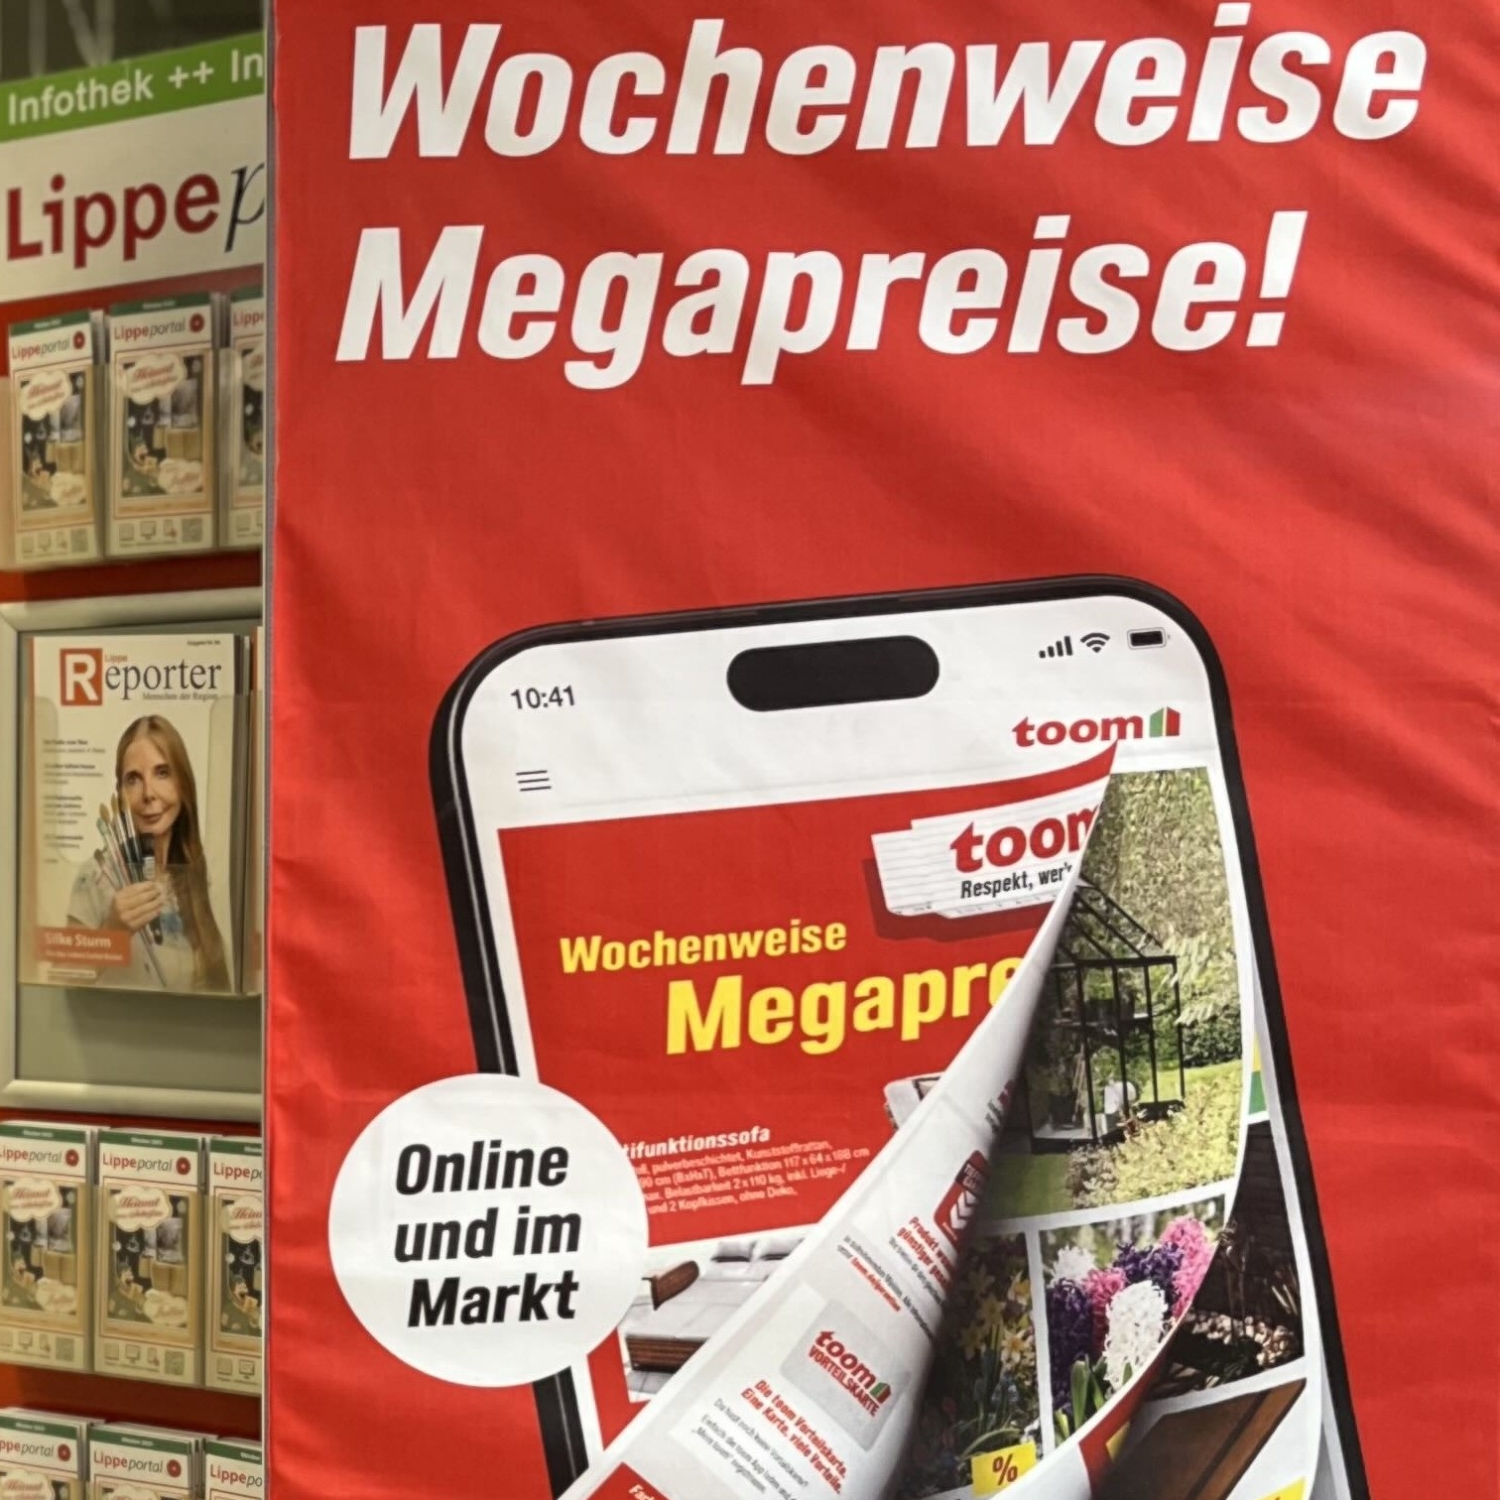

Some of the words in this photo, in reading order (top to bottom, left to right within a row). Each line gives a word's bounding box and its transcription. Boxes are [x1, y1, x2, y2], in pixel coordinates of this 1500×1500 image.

[8, 69, 154, 126] Infothek
[349, 2, 1427, 159] Wochenweise
[335, 211, 1308, 389] Megapreise!
[11, 337, 70, 360] Lippeportal
[113, 318, 186, 341] Lippeportal
[510, 685, 577, 712] 10:41
[1012, 710, 1143, 748] toom
[960, 871, 1033, 899] Respekt,
[44, 933, 73, 946] Silke
[75, 933, 111, 949] Sturm
[560, 920, 846, 974] Wochenweise
[102, 1153, 172, 1172] Lippeportal
[395, 1139, 569, 1195] Online
[649, 1203, 666, 1213] und
[740, 1190, 764, 1200] ohne
[665, 1182, 730, 1198] Belastbarkeit
[750, 1175, 766, 1185] 110
[394, 1206, 499, 1263] und
[513, 1205, 581, 1256] im
[910, 1218, 938, 1249] Produkt
[407, 1270, 579, 1328] Markt
[814, 1329, 876, 1392] toom
[807, 1346, 882, 1418] VORTEILSKARTE
[742, 1388, 762, 1409] Eine
[790, 1435, 811, 1456] viele
[810, 1454, 841, 1493] Vorteile.
[755, 1380, 772, 1397] Die
[772, 1395, 795, 1420] toom
[796, 1418, 846, 1477] Vorteilskarte.
[93, 1449, 163, 1474] Lippeportal
[992, 1454, 1018, 1486] %
